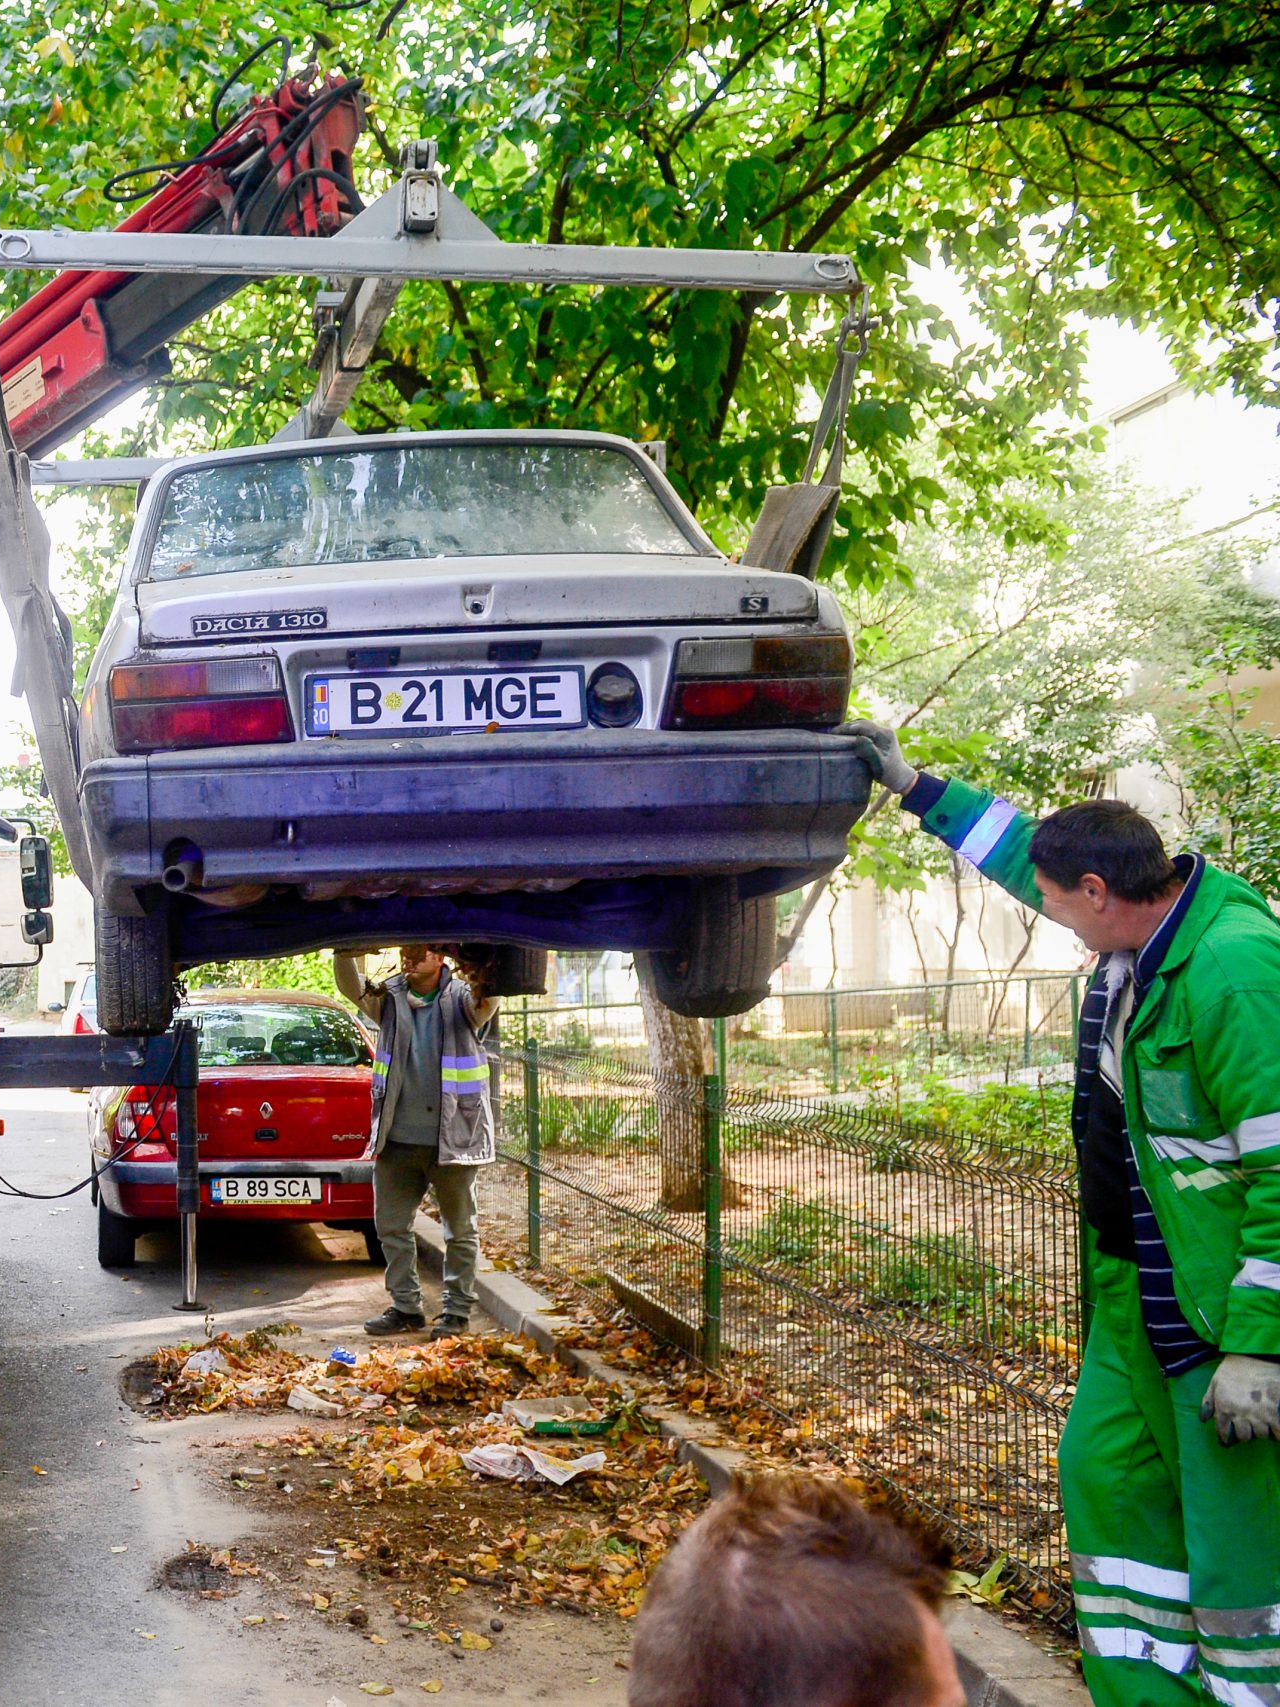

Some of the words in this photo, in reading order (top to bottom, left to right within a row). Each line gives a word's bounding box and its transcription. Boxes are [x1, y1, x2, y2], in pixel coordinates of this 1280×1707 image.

[749, 597, 761, 610] S
[195, 615, 270, 633] DACIA
[279, 613, 324, 628] 1310
[313, 708, 329, 725] RO
[350, 682, 382, 725] B
[401, 679, 443, 722] 21
[464, 675, 562, 721] MGE
[226, 1180, 239, 1197] B
[247, 1180, 268, 1197] 89
[275, 1180, 311, 1197] SCA
